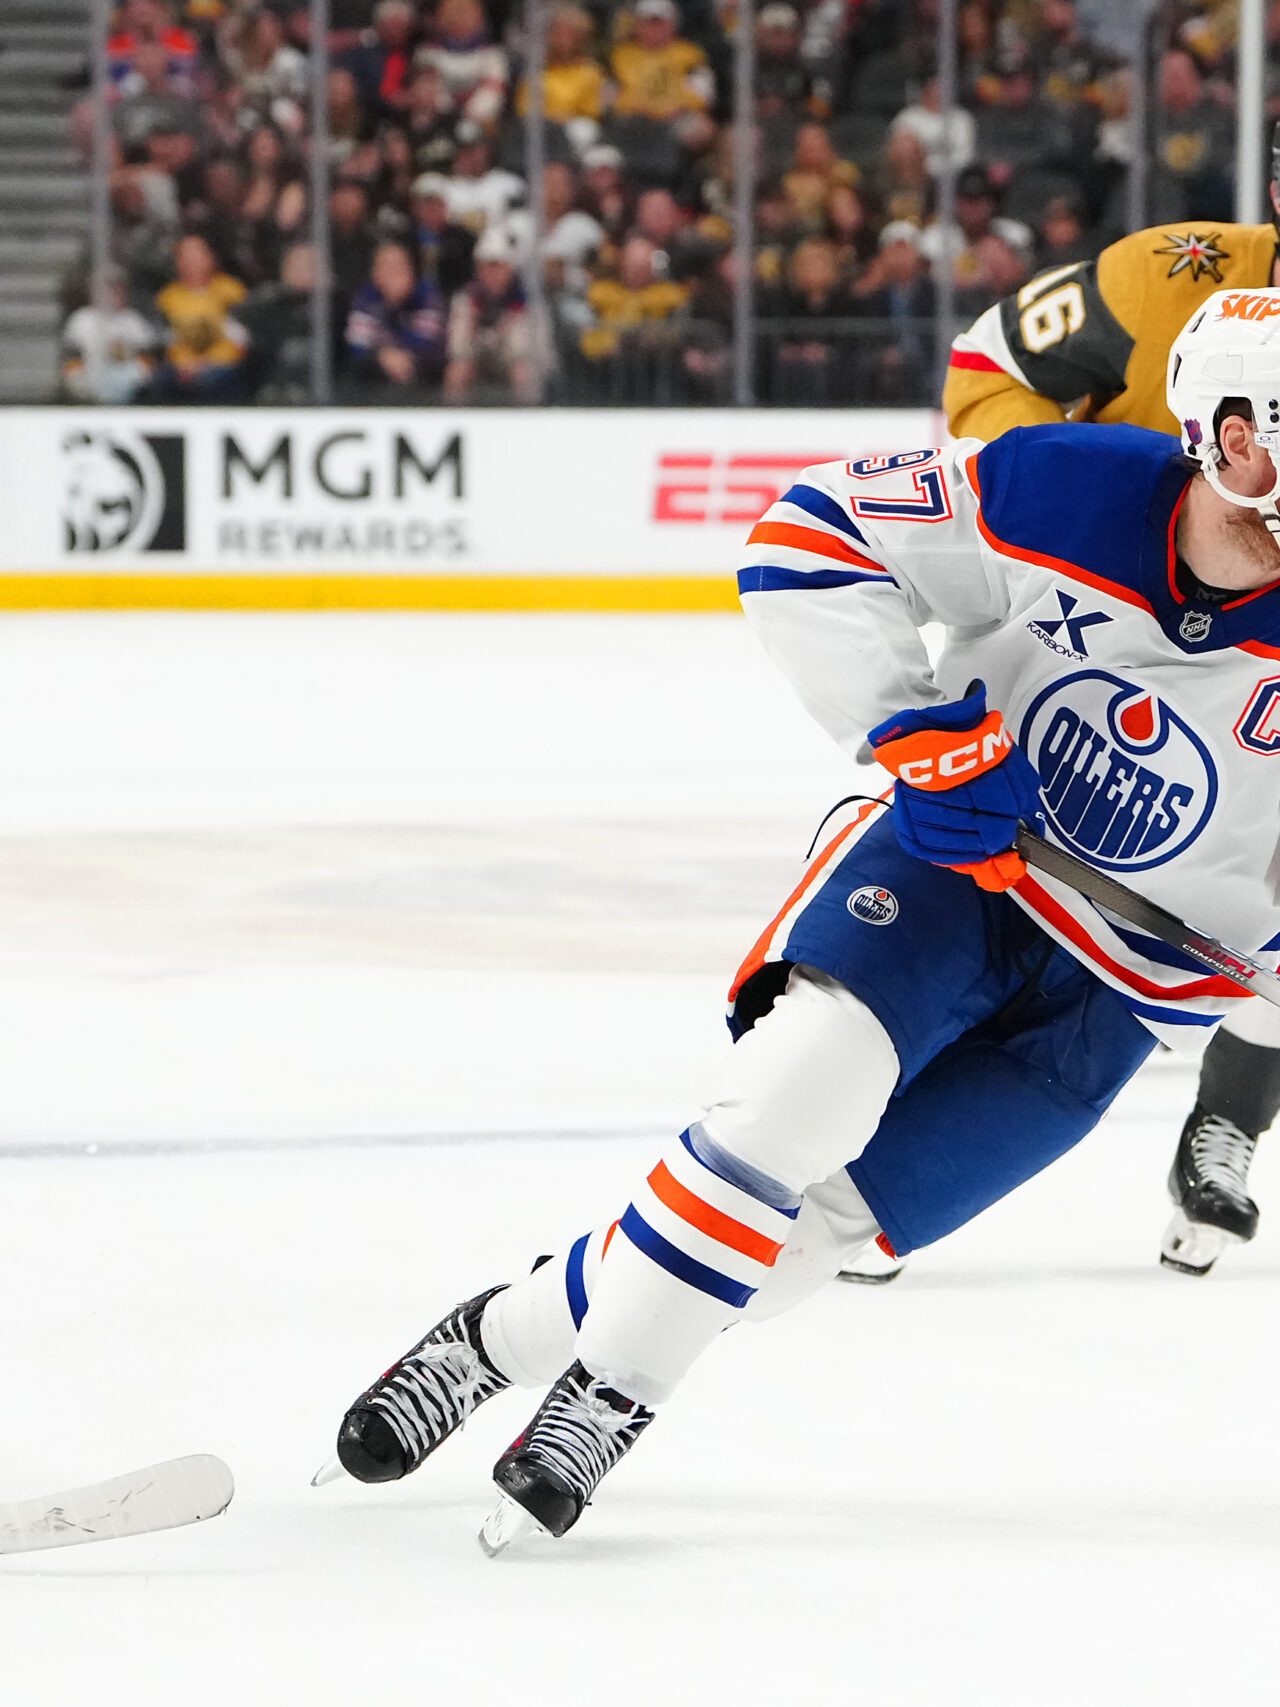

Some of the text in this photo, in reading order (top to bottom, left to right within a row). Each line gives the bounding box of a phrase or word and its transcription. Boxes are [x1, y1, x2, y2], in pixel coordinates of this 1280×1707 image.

[1017, 262, 1086, 354] 16
[222, 431, 463, 500] MGM
[846, 448, 953, 523] 97
[217, 517, 470, 552] REWARDS
[1026, 621, 1087, 662] KARBON-X
[1185, 621, 1207, 634] NHL
[898, 724, 1014, 784] CCM
[1038, 706, 1194, 859] OILERS
